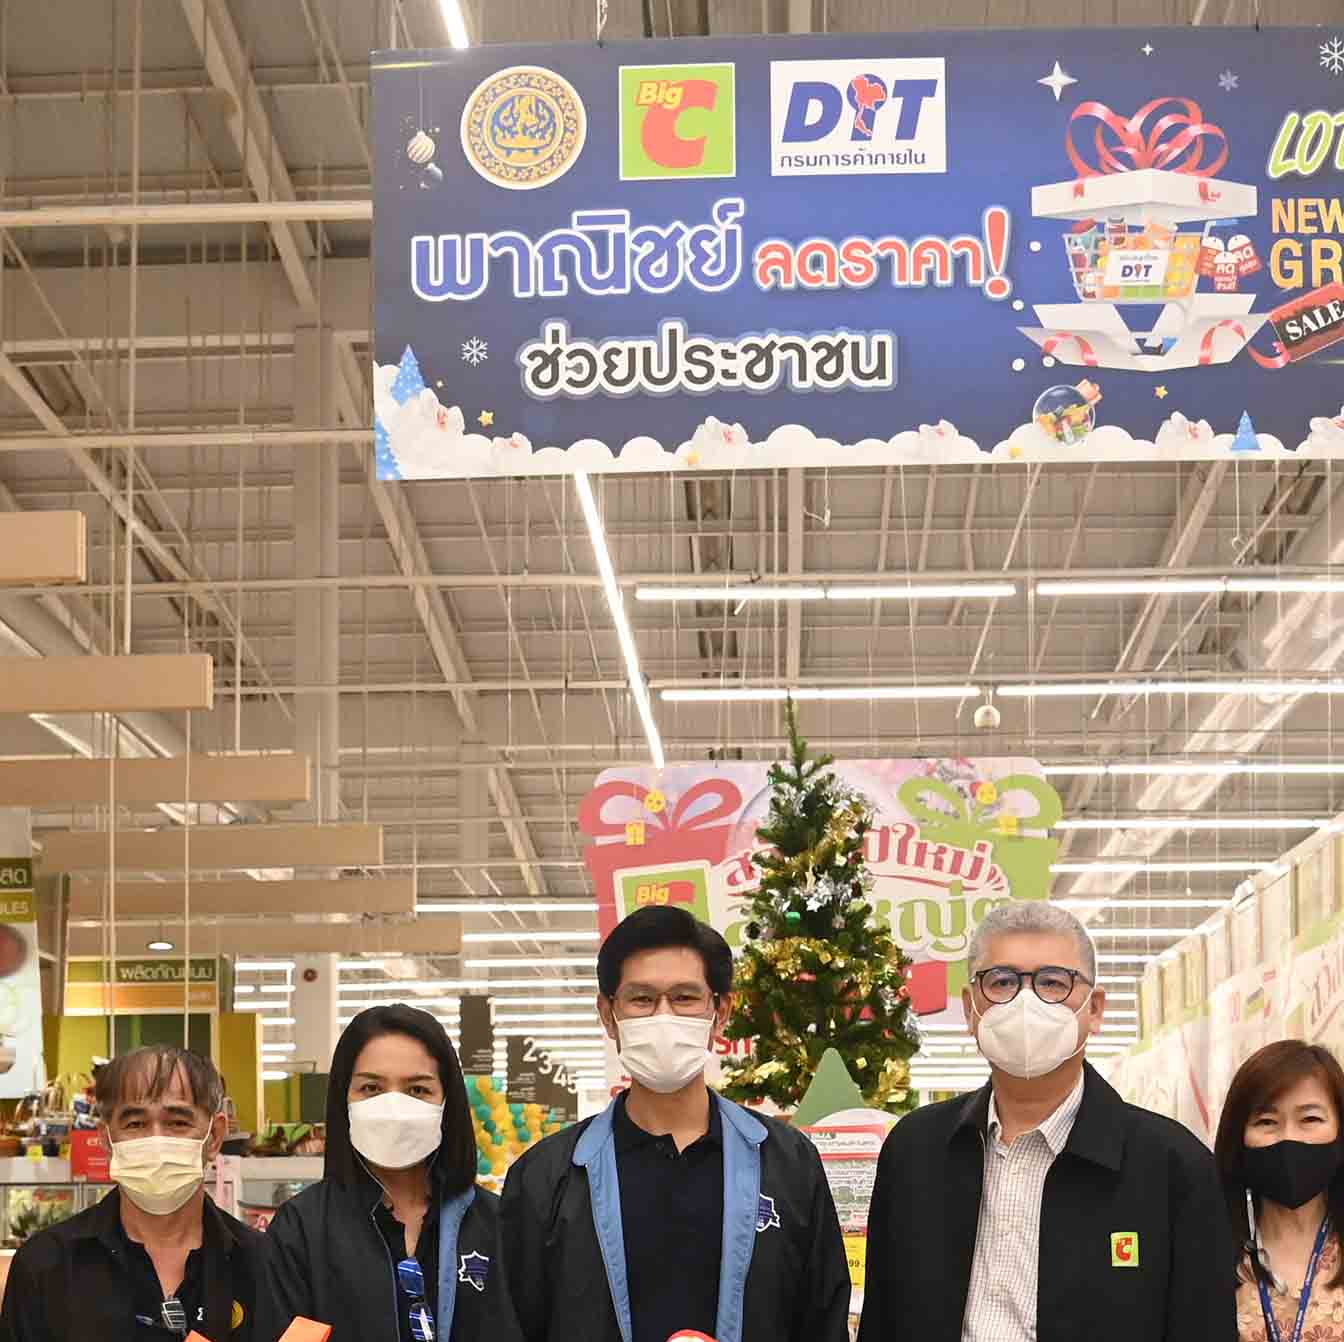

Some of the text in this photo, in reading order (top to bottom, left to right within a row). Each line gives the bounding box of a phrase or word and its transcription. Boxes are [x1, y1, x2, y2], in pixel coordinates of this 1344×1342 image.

[637, 81, 682, 109] Big
[642, 80, 718, 168] C
[779, 148, 926, 169] กรมการค้าภายใน
[411, 198, 1012, 301] พาณิชย์ ลดราคา!
[524, 321, 892, 395] ช่วยประชาชน
[636, 884, 669, 905] Big
[523, 1037, 538, 1062] 2
[538, 1050, 553, 1074] 3
[552, 1063, 567, 1087] 4
